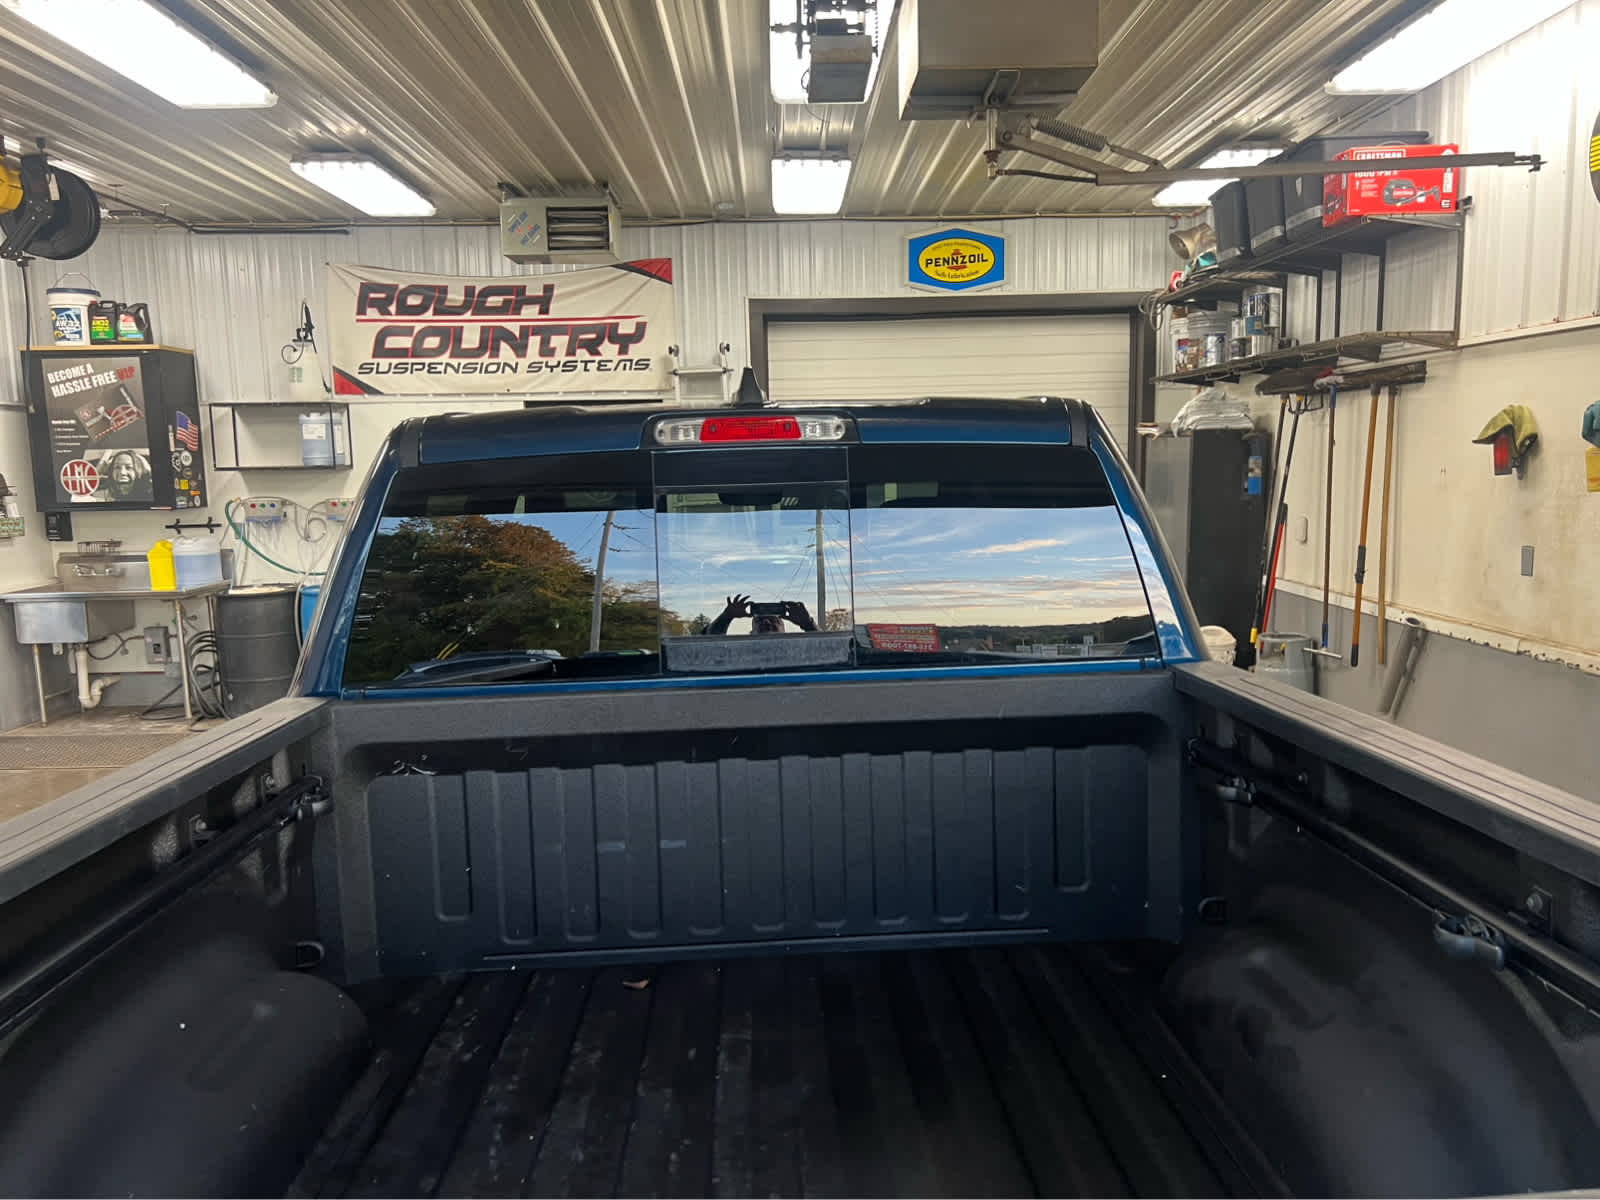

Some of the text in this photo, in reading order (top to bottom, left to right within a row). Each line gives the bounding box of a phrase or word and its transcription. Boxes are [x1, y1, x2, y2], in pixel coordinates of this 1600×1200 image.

[925, 253, 989, 268] PENNZOIL
[356, 282, 555, 316] ROUGH
[372, 321, 648, 358] COUNTRY
[47, 362, 94, 384] BECOME A
[358, 358, 651, 375] SUSPENSION SYSTEMS
[51, 365, 136, 398] HASSLE FREE VIP
